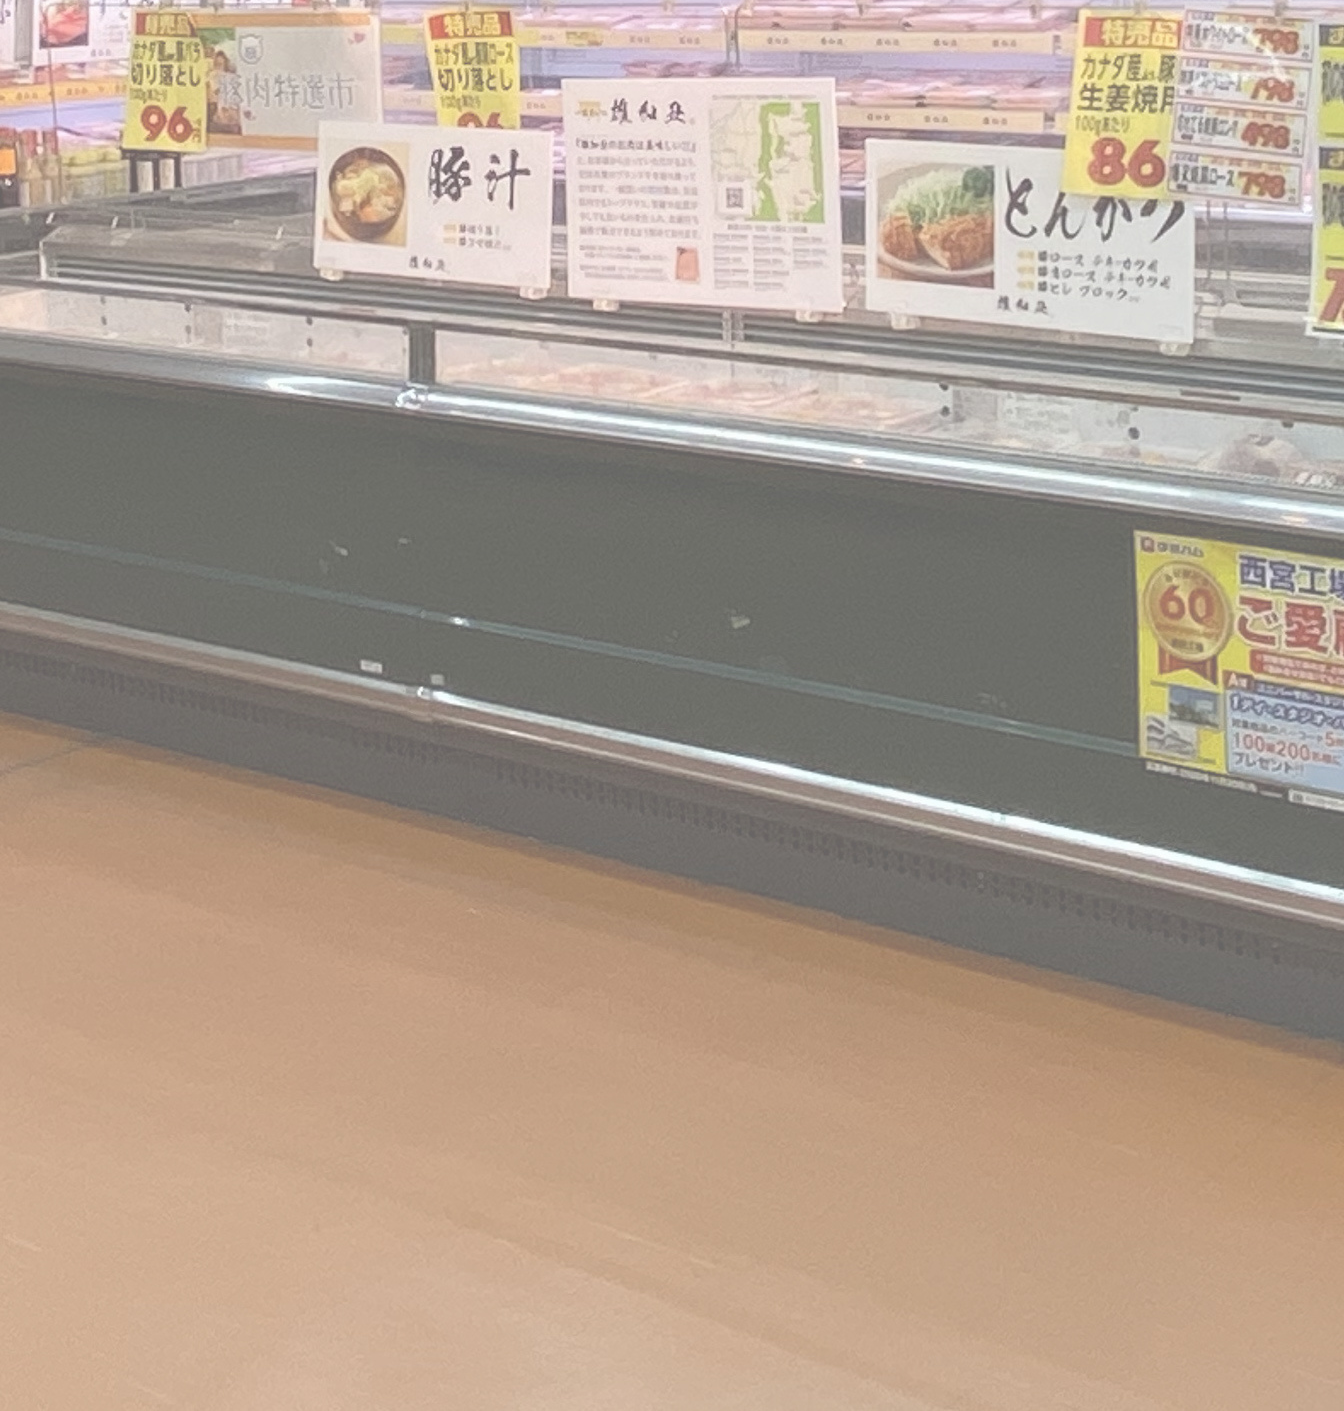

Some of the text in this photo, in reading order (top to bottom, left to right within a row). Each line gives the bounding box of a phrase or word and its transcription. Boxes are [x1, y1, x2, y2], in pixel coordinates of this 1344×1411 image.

[444, 15, 502, 38] 特売品
[1101, 19, 1179, 49] 特売品
[130, 64, 202, 87] 切り落とし
[435, 67, 515, 94] 切り落とし
[141, 104, 194, 143] 96
[1086, 137, 1167, 188] 86
[428, 145, 532, 211] 豚汁
[1238, 171, 1287, 199] 798
[1158, 585, 1215, 626] 60
